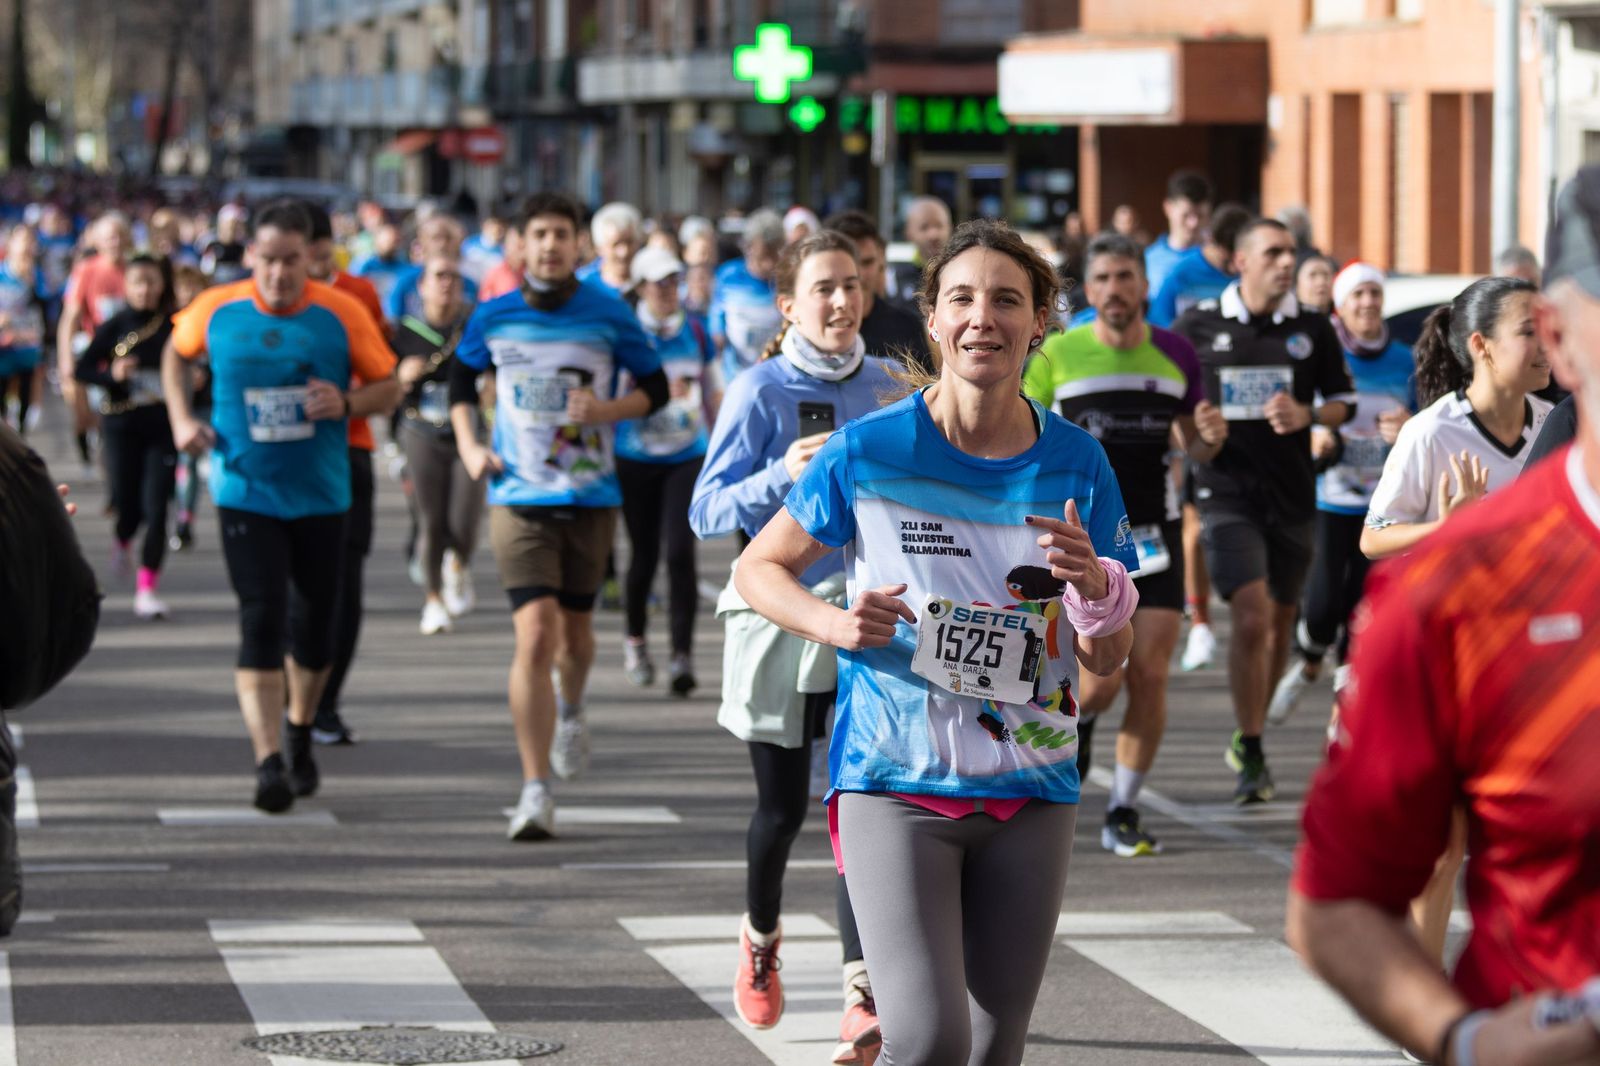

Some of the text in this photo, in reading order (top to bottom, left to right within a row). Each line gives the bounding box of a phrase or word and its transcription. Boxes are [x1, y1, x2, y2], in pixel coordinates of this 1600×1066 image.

[838, 97, 1060, 134] FRMAC
[900, 521, 943, 532] XLI SAN
[901, 533, 955, 544] SILVESTRE
[901, 545, 972, 557] SALMANTINA
[952, 606, 1034, 632] SETEL
[934, 622, 1007, 669] 1525
[942, 661, 988, 676] ANA DARIA
